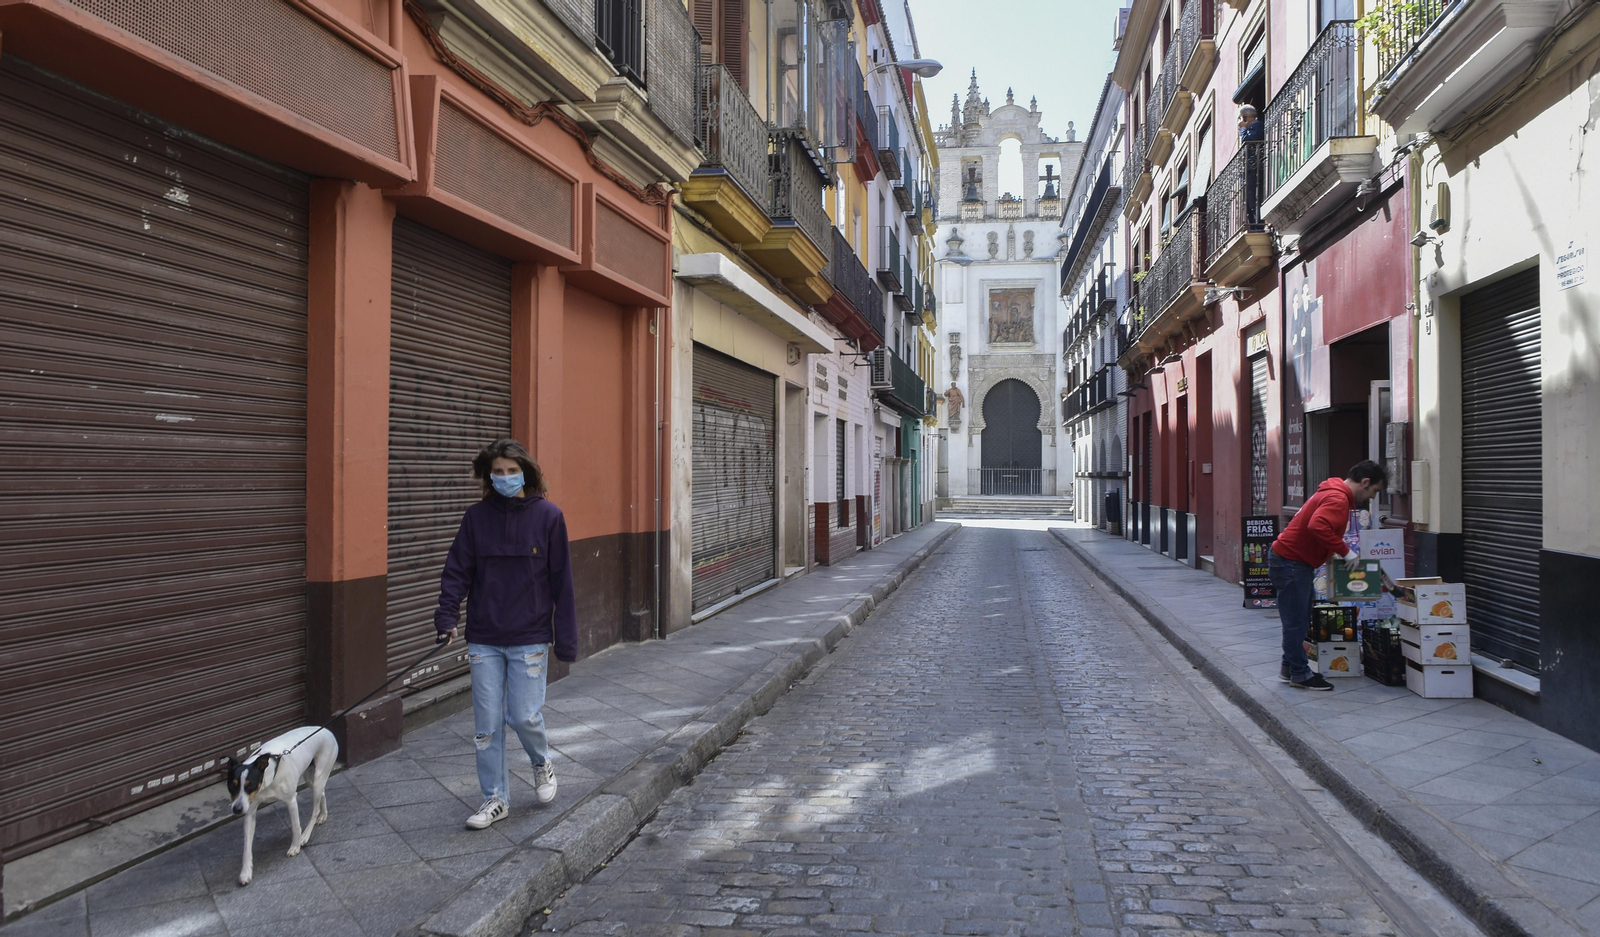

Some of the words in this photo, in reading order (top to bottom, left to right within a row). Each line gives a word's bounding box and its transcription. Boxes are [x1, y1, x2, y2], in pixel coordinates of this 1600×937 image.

[1557, 264, 1584, 279] PROTEGIDO
[1288, 417, 1303, 434] drinks
[1288, 459, 1302, 475] fruits
[1246, 525, 1273, 534] FRÍAS
[1370, 546, 1396, 556] evian
